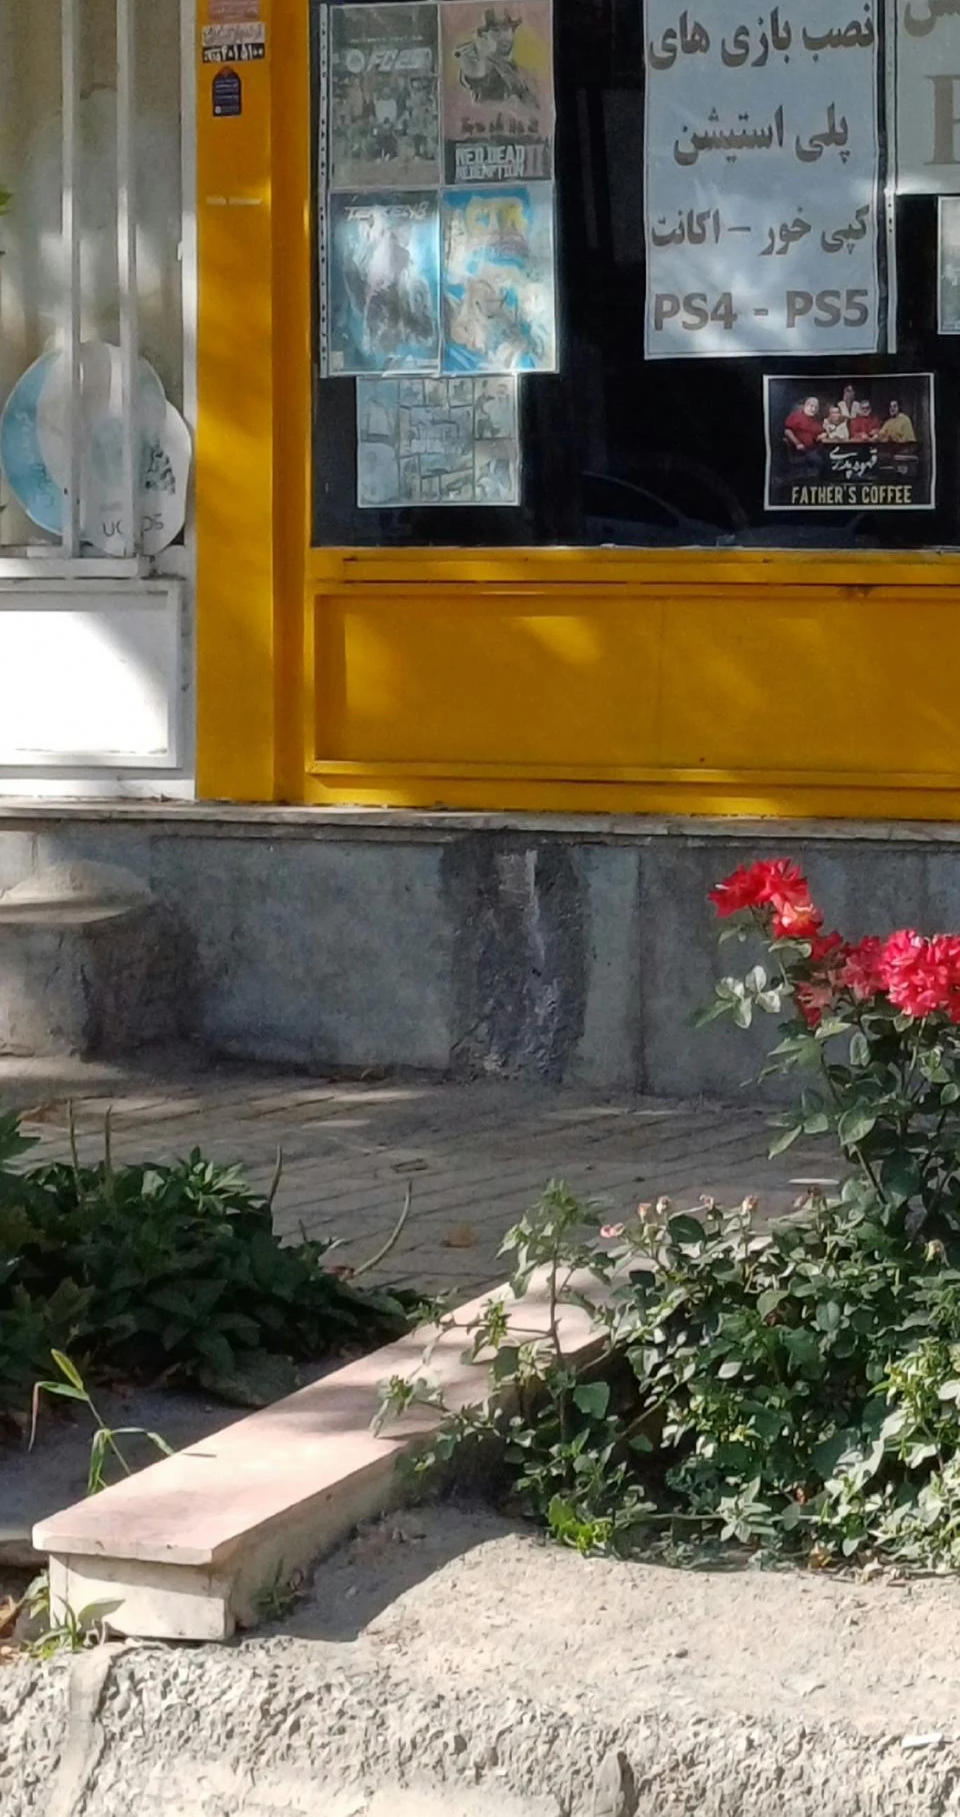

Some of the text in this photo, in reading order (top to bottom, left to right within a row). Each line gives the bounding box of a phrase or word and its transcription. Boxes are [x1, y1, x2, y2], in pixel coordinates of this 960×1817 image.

[649, 2, 875, 71] نصب بازی های
[673, 101, 851, 167] پلی استیشن
[650, 208, 721, 248] اکانت
[758, 206, 812, 256] خور
[820, 203, 871, 255] کپی
[653, 291, 738, 332] PS4
[785, 288, 870, 330] PS5
[791, 484, 913, 505] FATHER'S COFFEE
